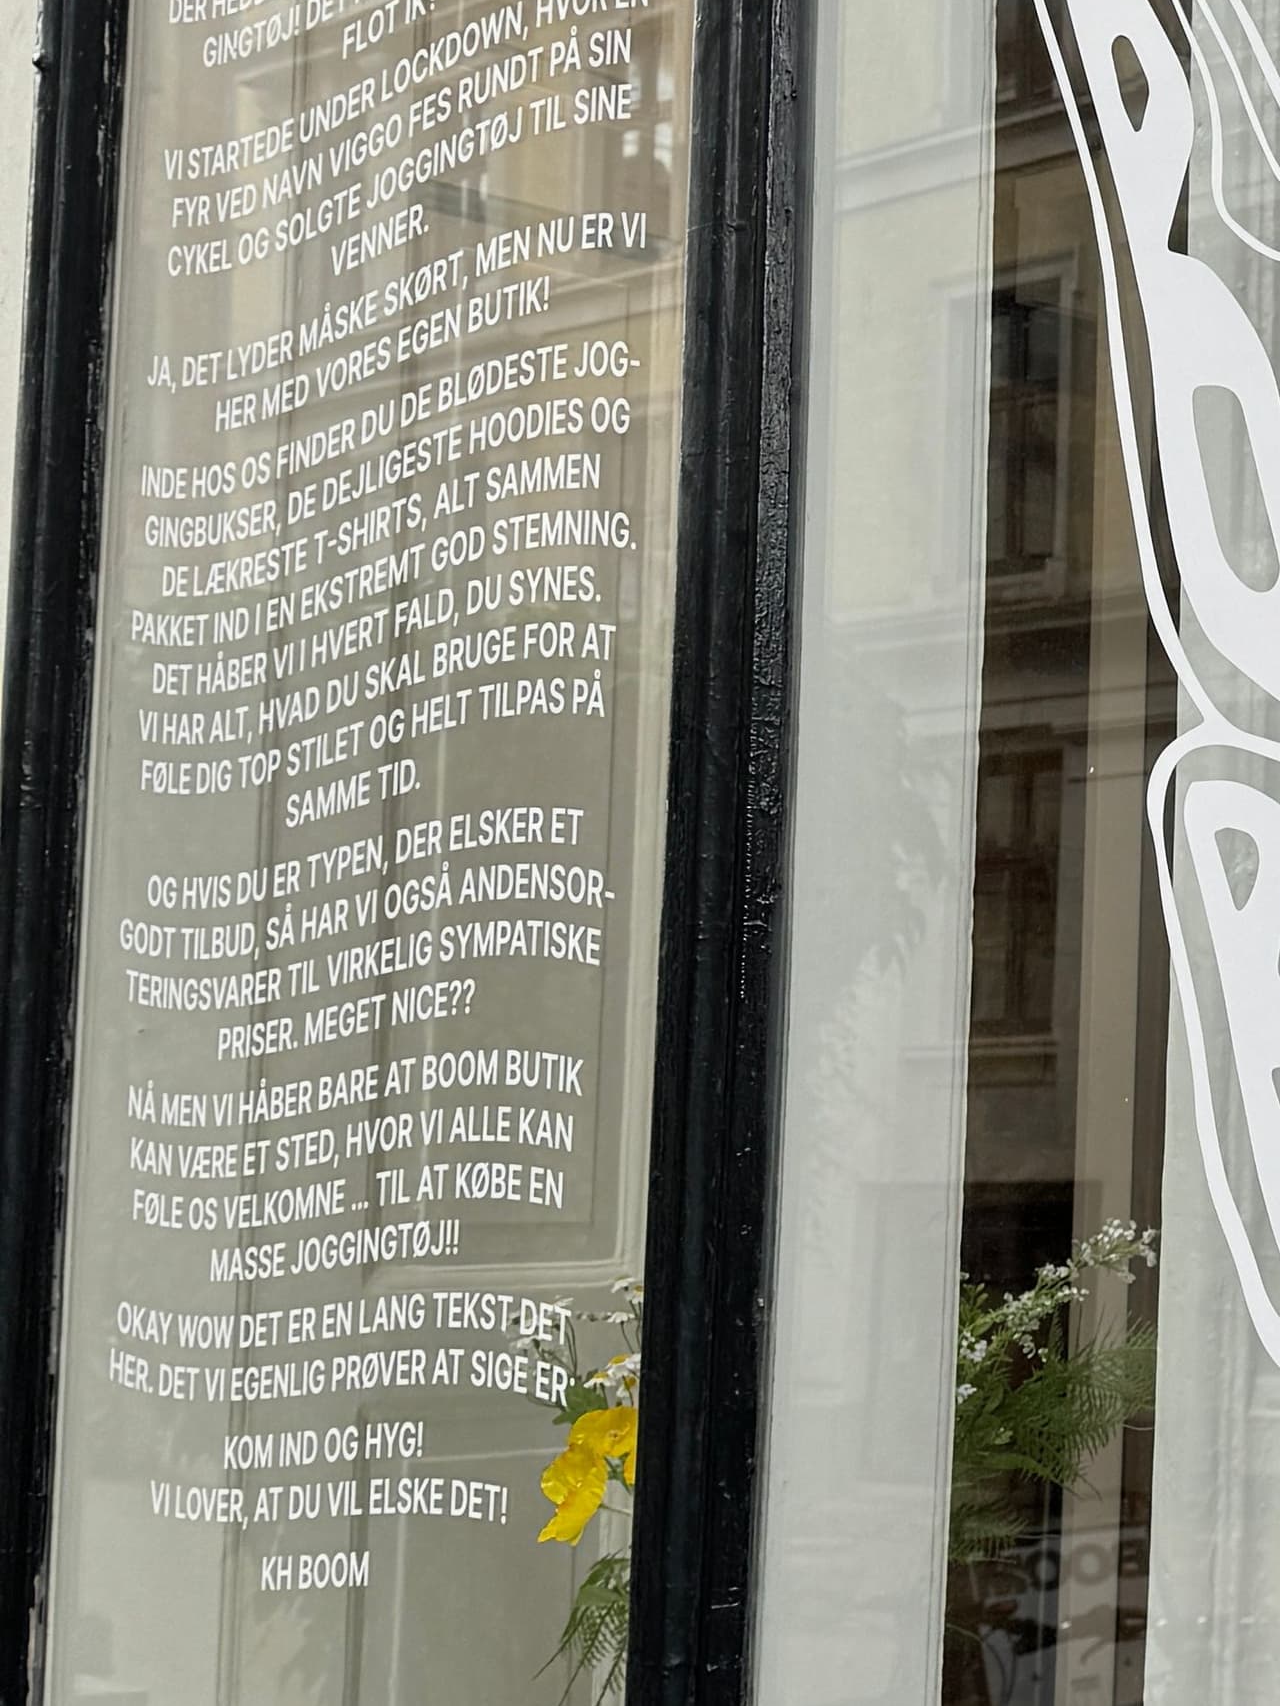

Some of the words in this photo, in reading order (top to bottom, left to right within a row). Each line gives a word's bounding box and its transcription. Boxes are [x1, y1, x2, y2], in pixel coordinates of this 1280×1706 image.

[164, 148, 184, 181] VI
[187, 117, 295, 180] STARTEDE
[299, 77, 376, 143] UNDER
[380, 0, 529, 102] LOCKDOWN,
[330, 203, 429, 276] VENNER.
[147, 355, 177, 394] JA,
[181, 351, 224, 388] DET
[226, 329, 294, 381] LYDER
[298, 289, 379, 357] MÅSKE
[383, 248, 468, 317] SKØRT,
[475, 225, 531, 278] MEN
[537, 216, 575, 258] NU
[581, 212, 614, 250] ER
[621, 211, 647, 249] VI
[141, 464, 188, 500] INDE
[191, 461, 237, 499] HOS
[240, 451, 272, 489] OS
[276, 418, 356, 479] FINDER
[360, 399, 395, 446] DU
[400, 383, 433, 428] DE
[437, 343, 569, 413] BLØDESTE
[573, 340, 643, 378] JOG-
[161, 565, 190, 598] DE
[192, 537, 309, 597] LÆKRESTE
[313, 492, 427, 565] T-SHIRTS,
[433, 471, 481, 520] ALT
[485, 453, 601, 502] SAMMEN
[152, 662, 193, 696] DET
[196, 650, 267, 695] HÅBER
[273, 642, 295, 679] VI
[299, 638, 306, 672] I
[311, 607, 390, 668] HVERT
[394, 588, 459, 638] FALD,
[466, 573, 503, 616] DU
[508, 565, 601, 606] SYNES.
[138, 708, 158, 743] VI
[162, 712, 205, 745] HAR
[208, 705, 253, 745] ALT,
[258, 686, 320, 735] HVAD
[326, 670, 359, 714] DU
[364, 649, 426, 700] SKAL
[432, 625, 517, 678] BRUGE
[523, 621, 575, 659] FOR
[581, 622, 617, 661] AT
[285, 770, 371, 828] SAMME
[377, 758, 421, 800] TID.
[147, 874, 177, 909] OG
[182, 874, 232, 910] HVIS
[236, 867, 268, 906] DU
[273, 860, 301, 898] ER
[306, 835, 388, 888] TYPEN,
[395, 820, 443, 864] DER
[449, 807, 544, 851] ELSKER
[550, 807, 584, 846] ET
[125, 967, 282, 1011] TERINGSVARER
[287, 959, 320, 997] TIL
[327, 930, 433, 987] VIRKELIG
[439, 919, 602, 966] SYMPATISKE
[127, 1079, 157, 1124] NÅ
[160, 1092, 207, 1128] MEN
[212, 1092, 234, 1127] VI
[238, 1077, 313, 1126] HÅBER
[318, 1064, 379, 1111] BARE
[384, 1057, 417, 1097] AT
[422, 1049, 499, 1091] BOOM
[505, 1049, 584, 1097] BUTIK
[130, 1136, 173, 1177] KAN
[177, 1144, 239, 1179] VÆRE
[243, 1139, 271, 1176] ET
[275, 1128, 339, 1172] STED,
[346, 1113, 413, 1159] HVOR
[420, 1108, 444, 1146] VI
[449, 1105, 512, 1143] ALLE
[518, 1107, 574, 1152] KAN
[210, 1242, 287, 1282] MASSE
[290, 1219, 460, 1275] JOGGINGTØJ!!
[117, 1301, 173, 1346] OKAY
[177, 1314, 235, 1350] WOW
[239, 1310, 284, 1349] DET
[287, 1307, 317, 1344] ER
[322, 1300, 353, 1339] EN
[358, 1293, 425, 1334] LANG
[432, 1291, 515, 1334] TEKST
[518, 1296, 573, 1347] DET
[223, 1433, 274, 1470] KOM
[279, 1430, 318, 1468] IND
[324, 1425, 359, 1463] OG
[365, 1421, 424, 1459] HYG!
[150, 1479, 170, 1517] VI
[174, 1484, 249, 1530] LOVER,
[253, 1486, 284, 1523] AT
[288, 1483, 321, 1520] DU
[327, 1480, 363, 1517] VIL
[369, 1477, 444, 1515] ELSKE
[450, 1479, 508, 1525] DET!
[261, 1555, 293, 1591] KH
[298, 1551, 370, 1590] BOOM
